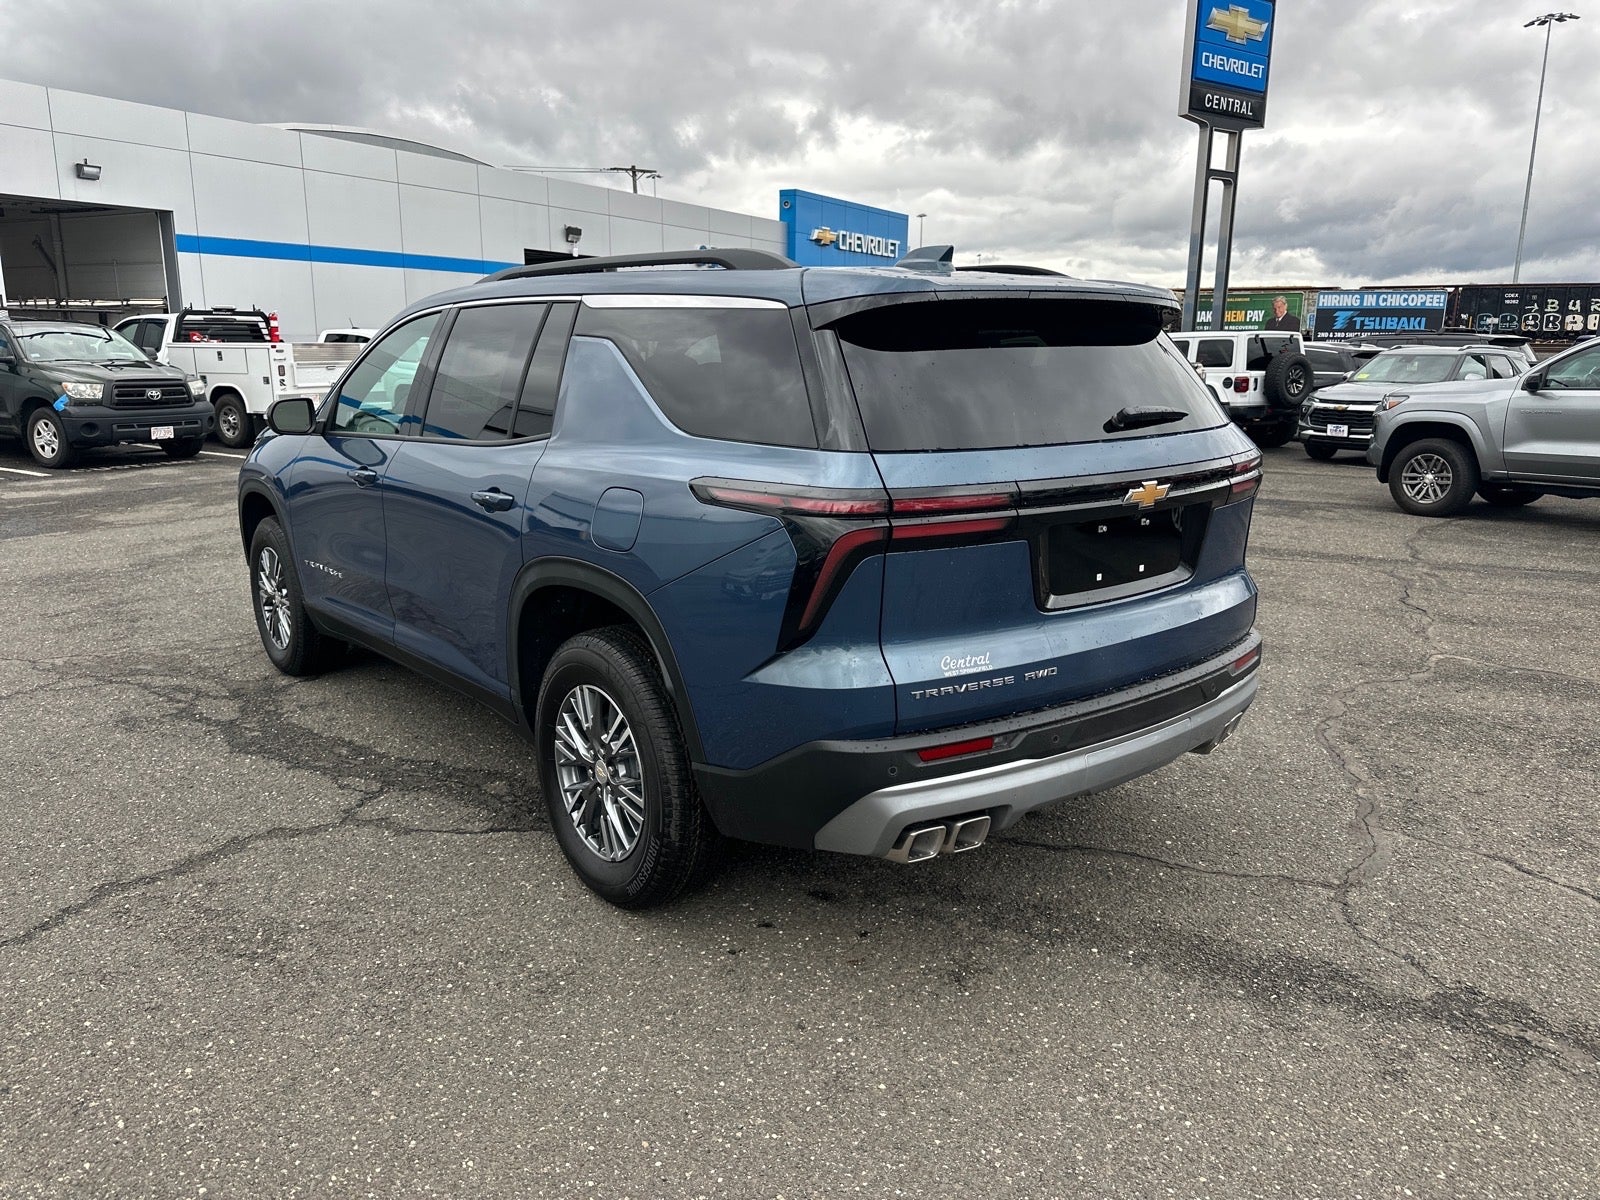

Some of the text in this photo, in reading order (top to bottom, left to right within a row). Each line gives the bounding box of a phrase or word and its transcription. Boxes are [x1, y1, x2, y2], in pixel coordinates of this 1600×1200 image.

[1201, 52, 1265, 78] CHEVROLET
[1204, 93, 1254, 116] CENTRAL
[838, 230, 900, 258] CHEVROLET
[1318, 294, 1445, 307] HIRING IN CHICOPEE!
[1224, 310, 1246, 322] HEM
[1246, 309, 1265, 321] PAY
[1353, 316, 1427, 330] TSUBAKI
[940, 652, 990, 671] Central
[943, 664, 993, 677] WEST SPRINGFIELD
[911, 667, 1058, 700] TRAVERSE AWD
